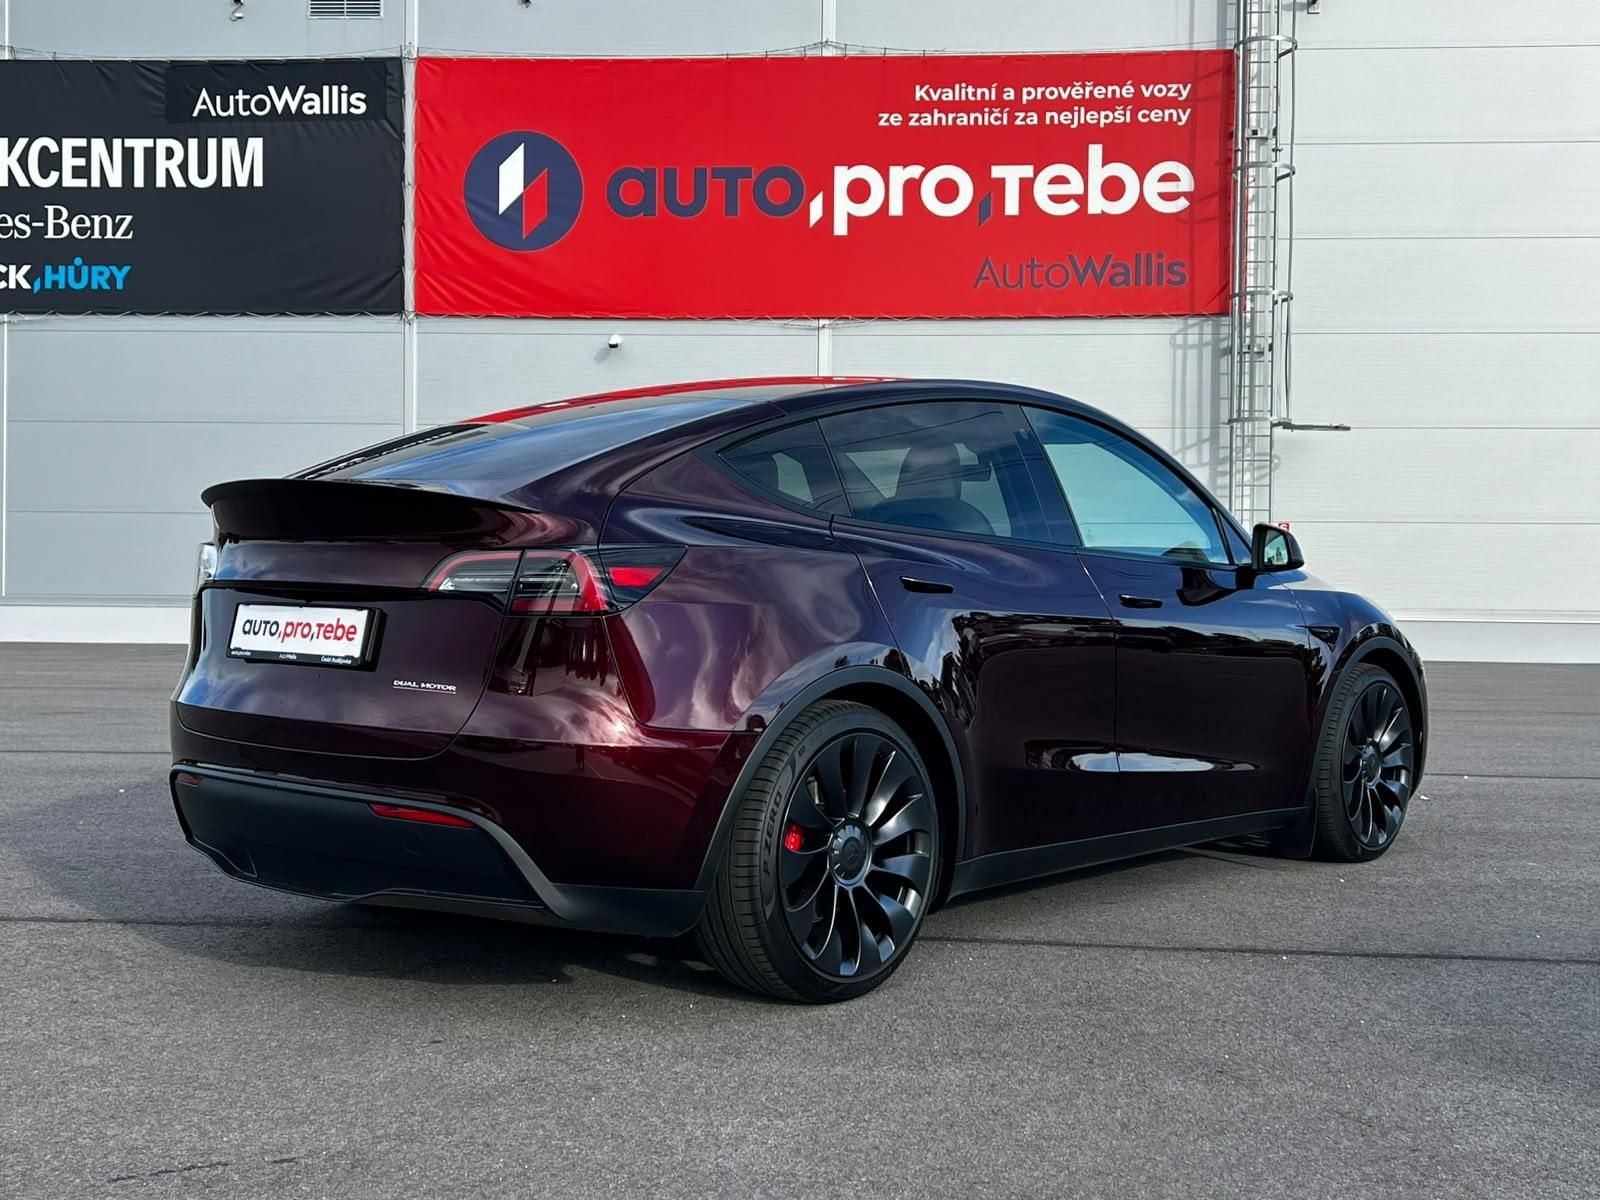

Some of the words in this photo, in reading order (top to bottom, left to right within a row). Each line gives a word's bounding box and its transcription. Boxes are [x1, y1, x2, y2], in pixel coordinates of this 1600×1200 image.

[191, 84, 367, 118] AutoWallis
[914, 82, 998, 102] Kvalitní
[1002, 86, 1015, 100] a
[1021, 80, 1135, 104] prověřené
[1140, 82, 1192, 100] vozy
[877, 111, 903, 126] ze
[908, 107, 1010, 127] zahraničí
[1014, 110, 1039, 126] za
[1045, 105, 1133, 128] nejlepší
[1137, 106, 1192, 126] ceny
[0, 136, 264, 189] KCENTRUM
[973, 251, 1188, 289] AutoWallis
[421, 683, 456, 691] MOTOR
